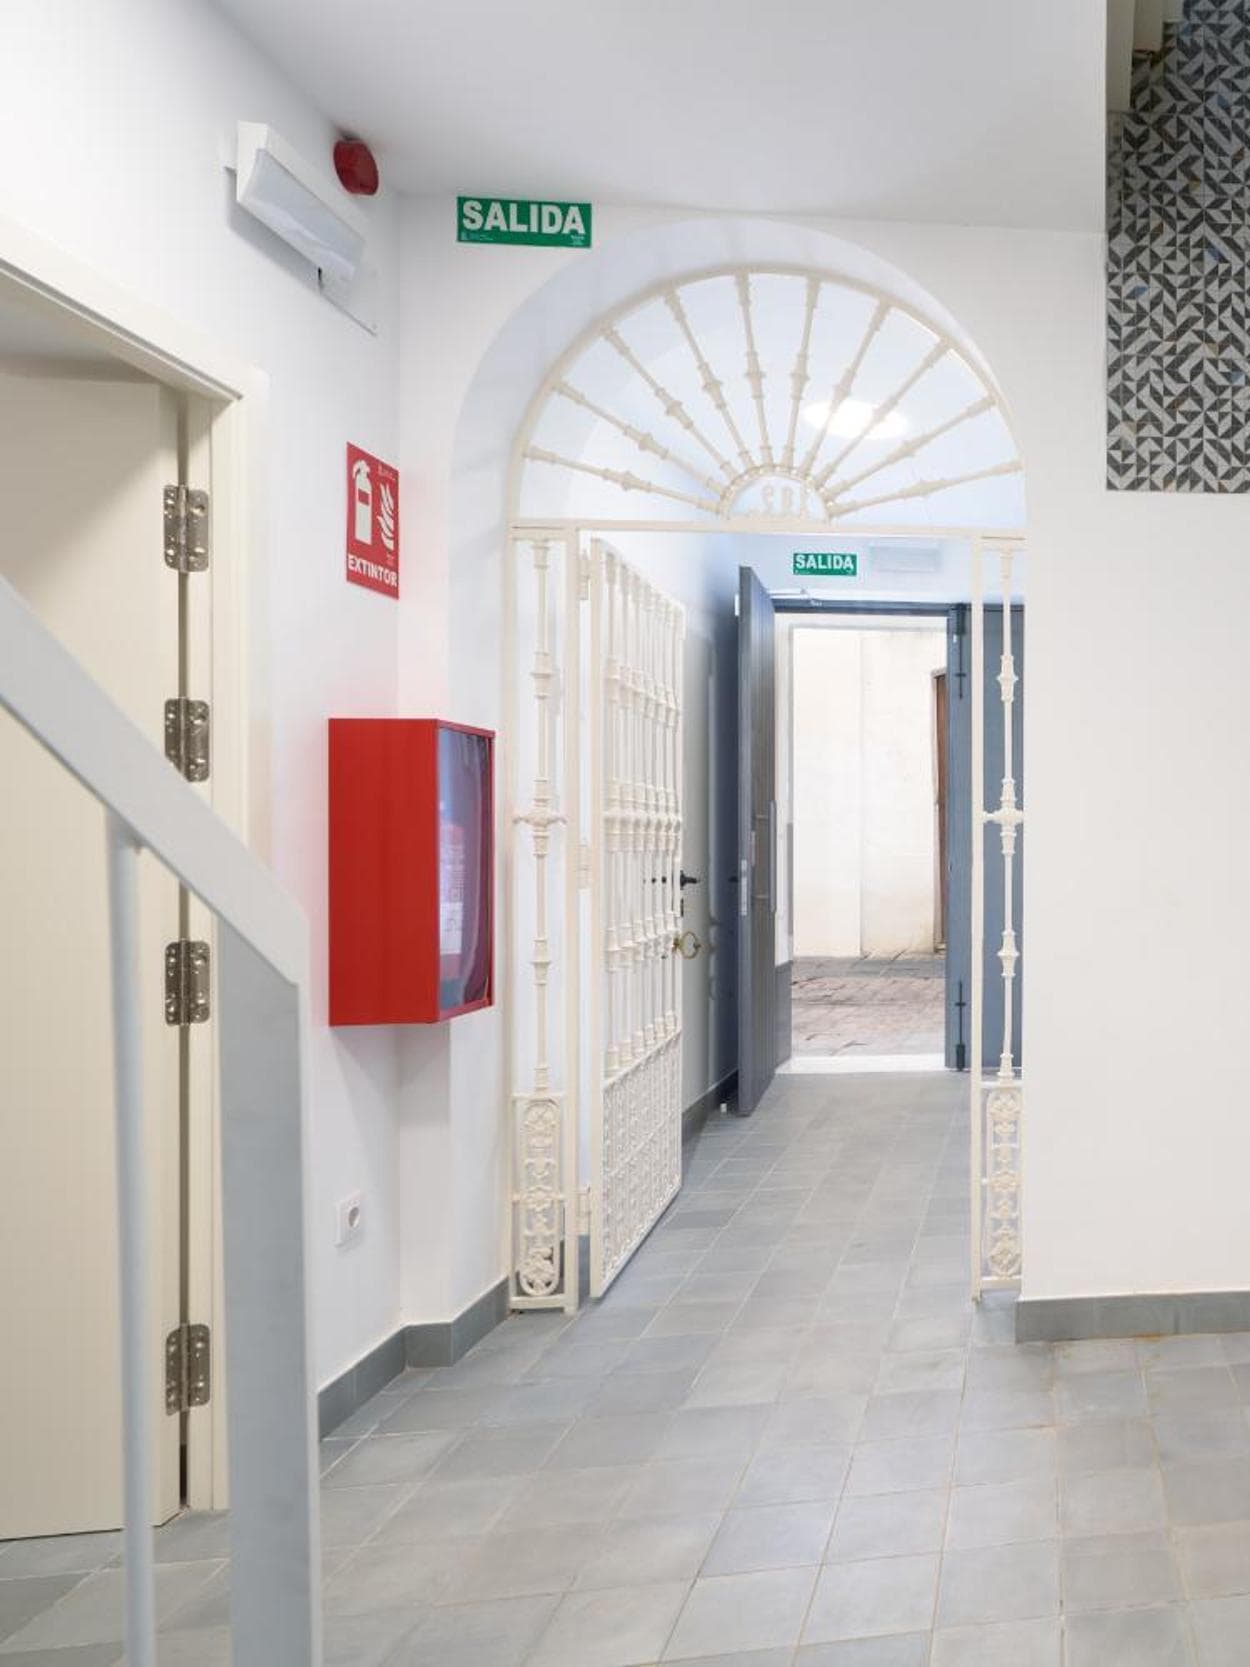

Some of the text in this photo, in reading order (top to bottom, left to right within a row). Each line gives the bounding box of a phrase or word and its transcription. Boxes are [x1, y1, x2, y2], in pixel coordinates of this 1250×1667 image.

[463, 200, 585, 234] SALIDA
[348, 553, 397, 587] EXTINTOR
[796, 555, 854, 569] SALIDA
